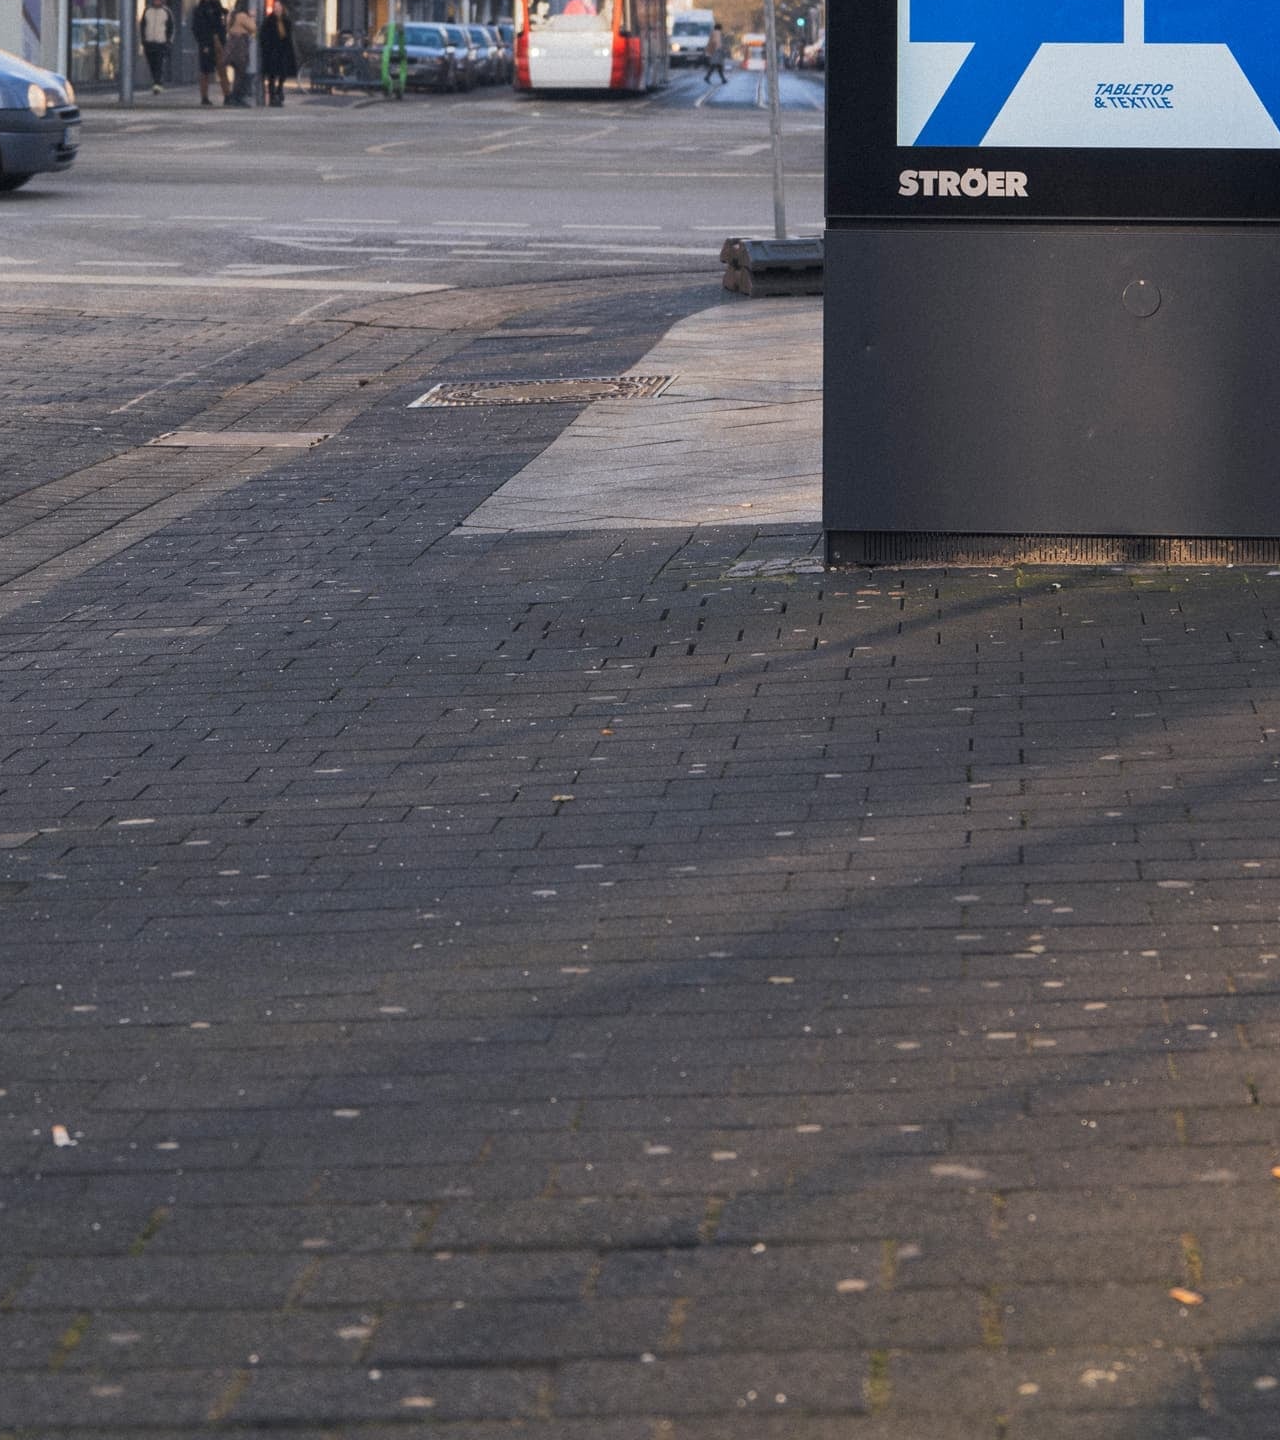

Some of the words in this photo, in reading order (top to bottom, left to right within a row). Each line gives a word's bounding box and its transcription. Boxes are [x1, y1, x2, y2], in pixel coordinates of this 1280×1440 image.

[1095, 83, 1174, 95] TABLETOP
[1094, 96, 1107, 108] &
[1107, 97, 1174, 108] TEXTILE
[898, 168, 1029, 197] STRÖER
